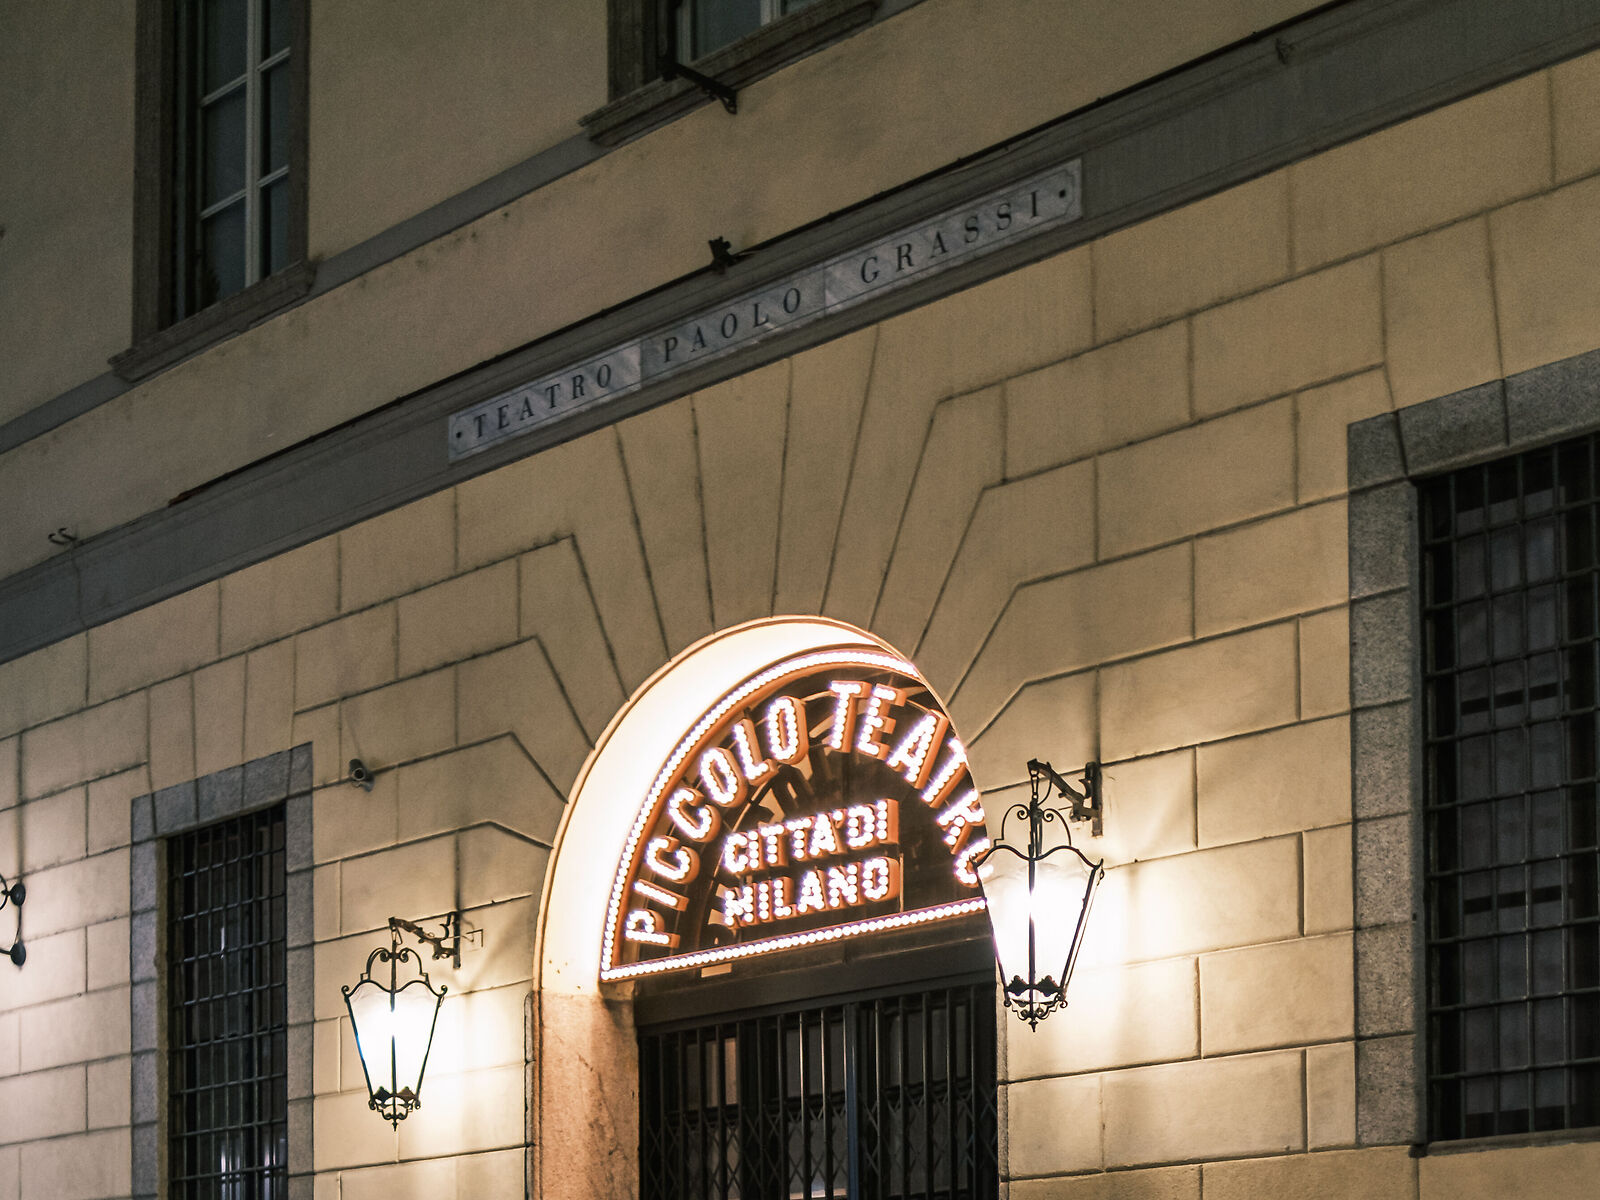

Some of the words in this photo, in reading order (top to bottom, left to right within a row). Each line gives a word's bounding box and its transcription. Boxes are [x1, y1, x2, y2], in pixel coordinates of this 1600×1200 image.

[473, 364, 612, 439] TEATRO
[663, 287, 801, 363] PAOLO
[860, 189, 1039, 284] GRASSI
[625, 696, 809, 949] PICCOLO
[724, 856, 900, 930] MILANO
